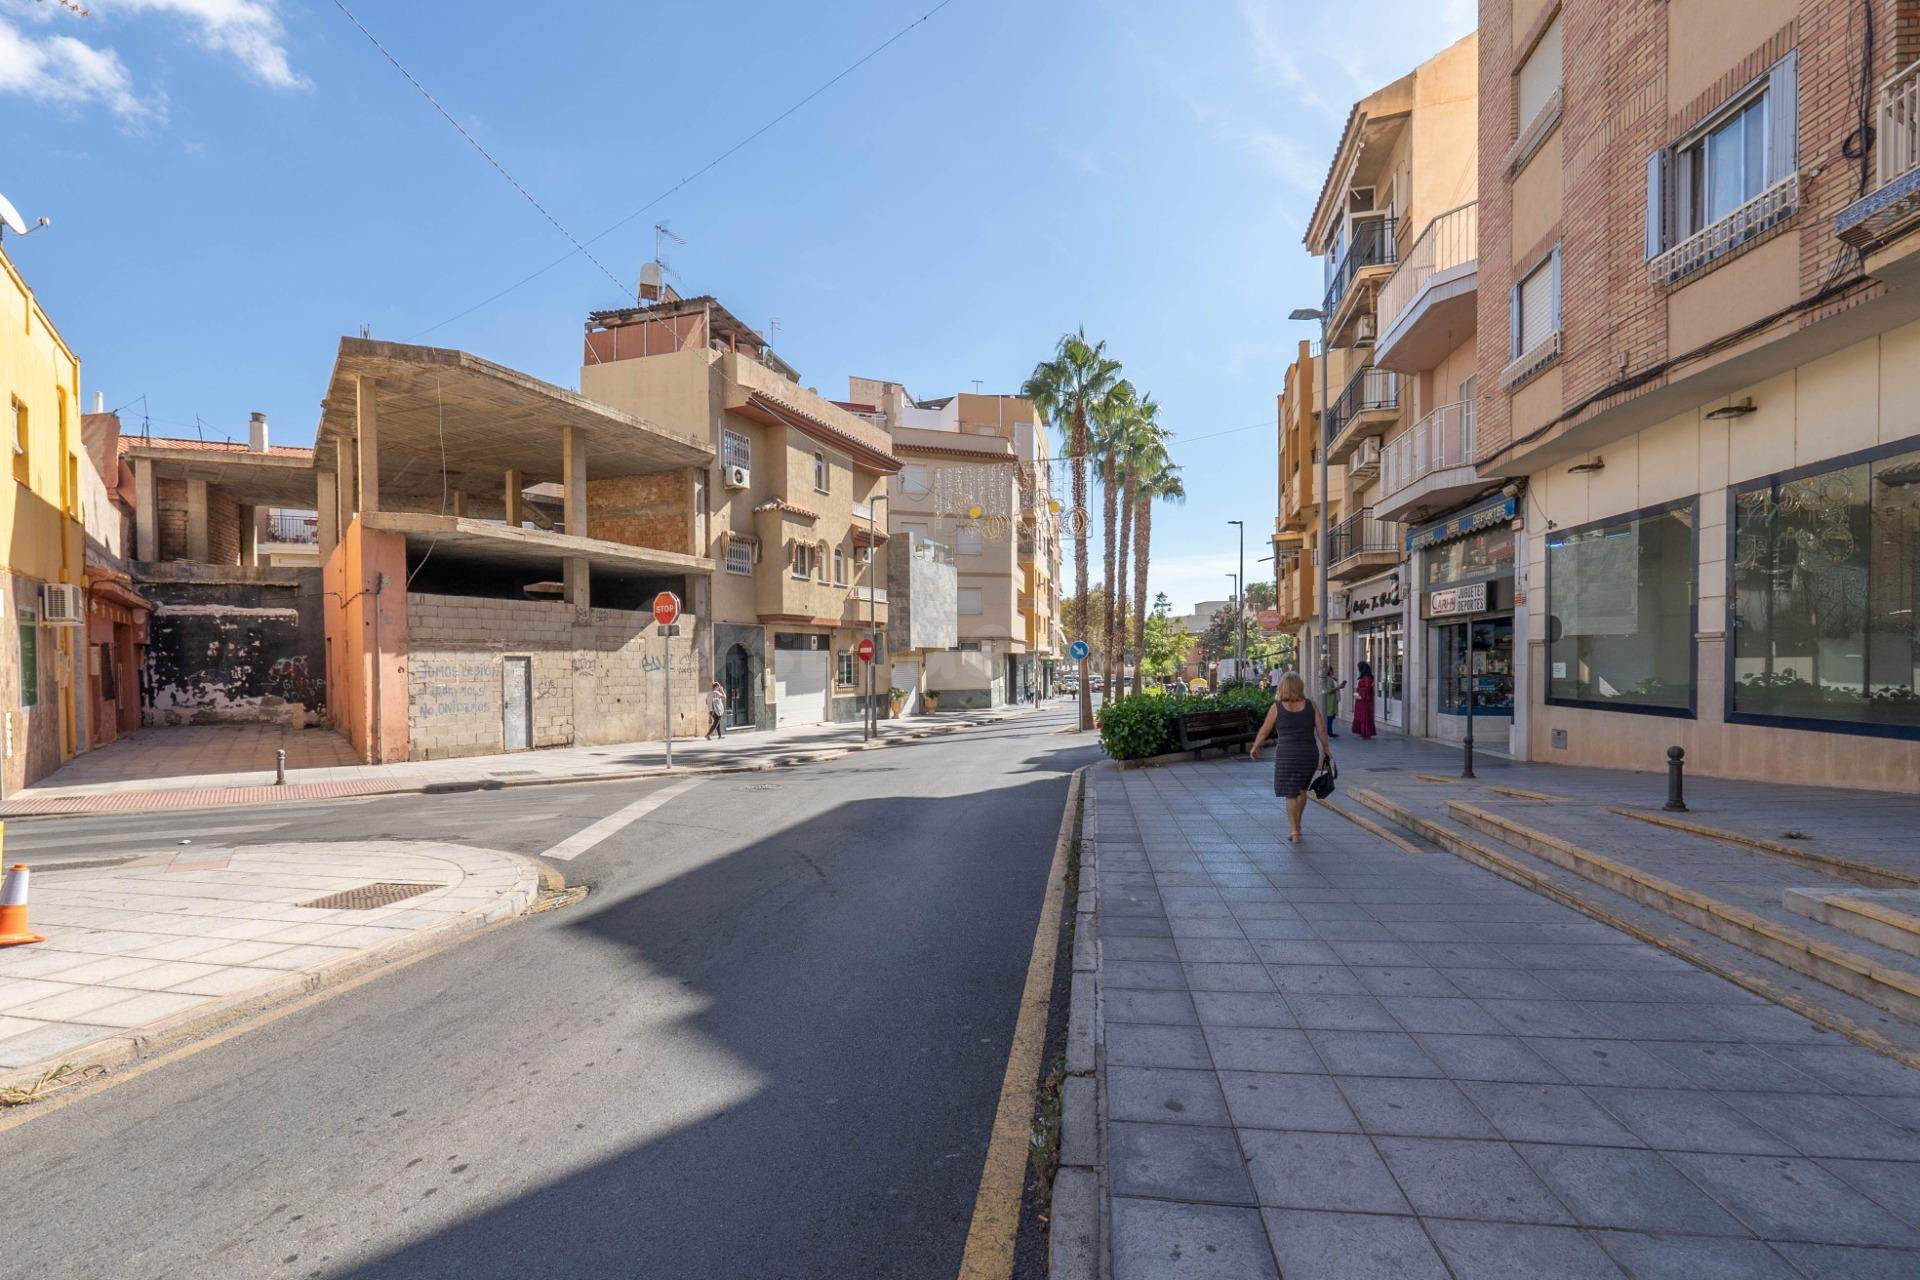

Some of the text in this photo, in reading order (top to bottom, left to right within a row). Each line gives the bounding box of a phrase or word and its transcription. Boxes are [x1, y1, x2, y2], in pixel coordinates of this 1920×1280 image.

[1458, 584, 1484, 600] JUGUETES
[655, 604, 674, 614] STOP
[1458, 598, 1484, 612] DEPORTES
